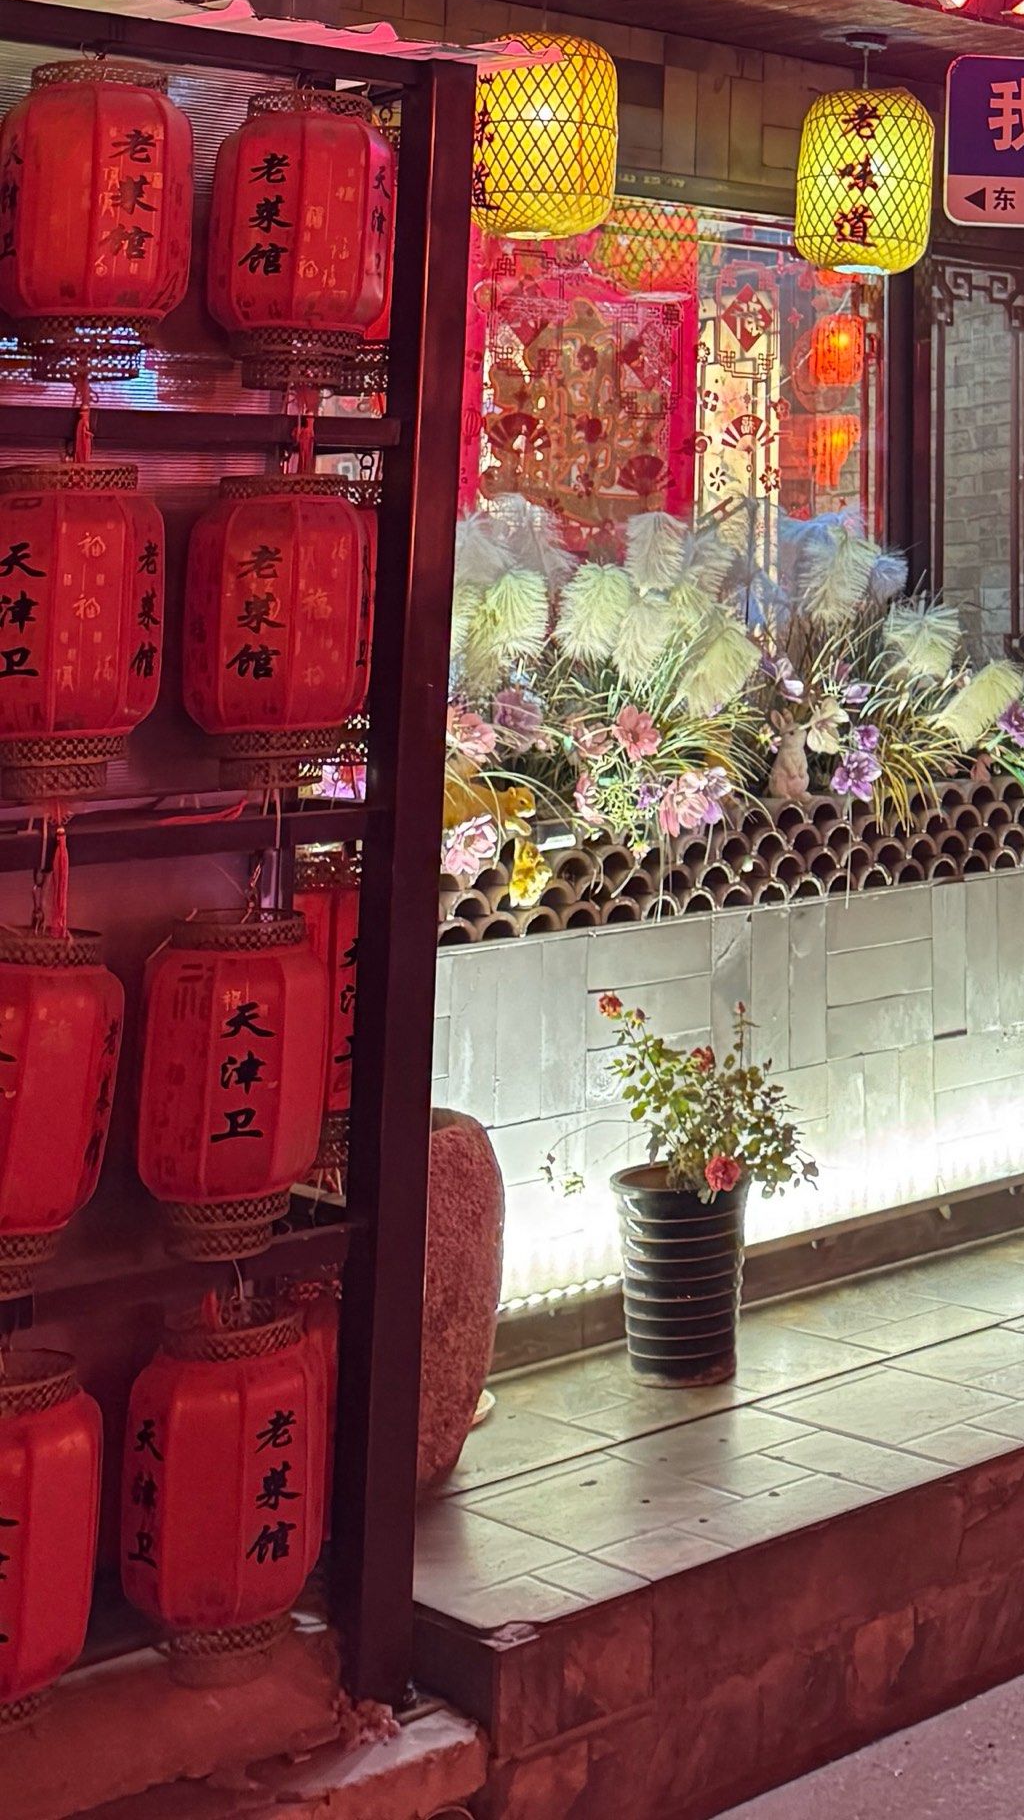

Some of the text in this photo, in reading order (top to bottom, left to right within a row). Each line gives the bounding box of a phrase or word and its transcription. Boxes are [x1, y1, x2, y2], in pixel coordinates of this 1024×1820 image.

[100, 129, 158, 260] 老菜馆
[238, 152, 293, 277] 老菜馆
[833, 102, 880, 248] 老味道
[993, 186, 1017, 212] 东
[0, 542, 47, 680] 天津卫
[131, 540, 161, 680] 老菜馆
[225, 544, 286, 680] 老菜馆
[210, 1001, 277, 1144] 天津卫
[246, 1410, 302, 1564] 老菜馆
